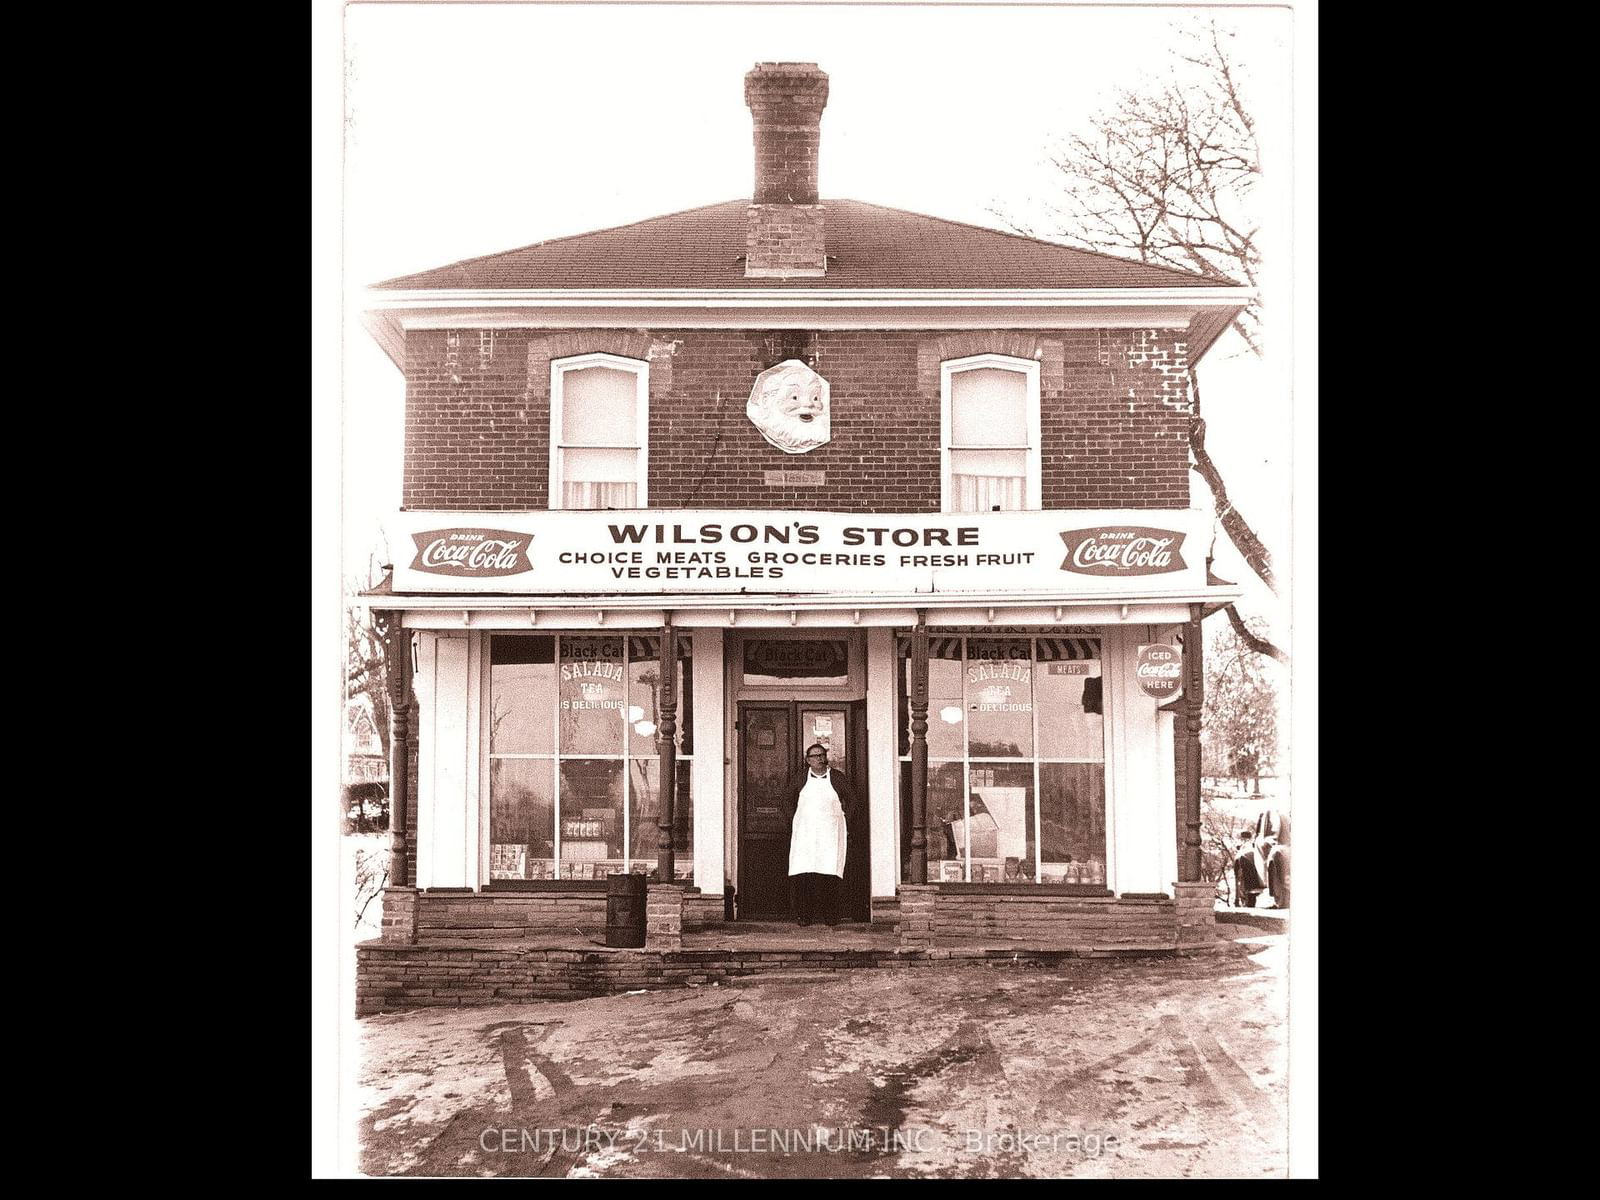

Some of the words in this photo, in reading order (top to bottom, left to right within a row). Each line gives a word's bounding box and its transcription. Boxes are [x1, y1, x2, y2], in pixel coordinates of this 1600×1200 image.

[450, 533, 485, 541] DRINK
[607, 522, 820, 545] WILSON'S
[842, 527, 979, 547] STORE
[1100, 532, 1135, 540] DRINK
[421, 538, 522, 569] Coca-Cola
[558, 551, 643, 565] CHOICE
[657, 551, 726, 564] MEATS
[747, 551, 886, 566] GROCERIES
[900, 554, 969, 567] FRESH
[976, 552, 1035, 566] FRUIT
[1073, 537, 1174, 568] Coca-Cola
[611, 566, 784, 579] VEGETABLES
[560, 643, 598, 659] Black
[966, 645, 1004, 660] Black
[1148, 651, 1172, 660] ICED
[561, 661, 623, 682] SALADA
[967, 664, 1031, 684] SALADA
[580, 683, 603, 694] TEA
[988, 686, 1011, 696] TEA
[1147, 680, 1174, 689] HERE
[560, 700, 570, 709] IS
[572, 700, 625, 710] DELICIOUS
[980, 703, 1033, 713] DELICIOUS
